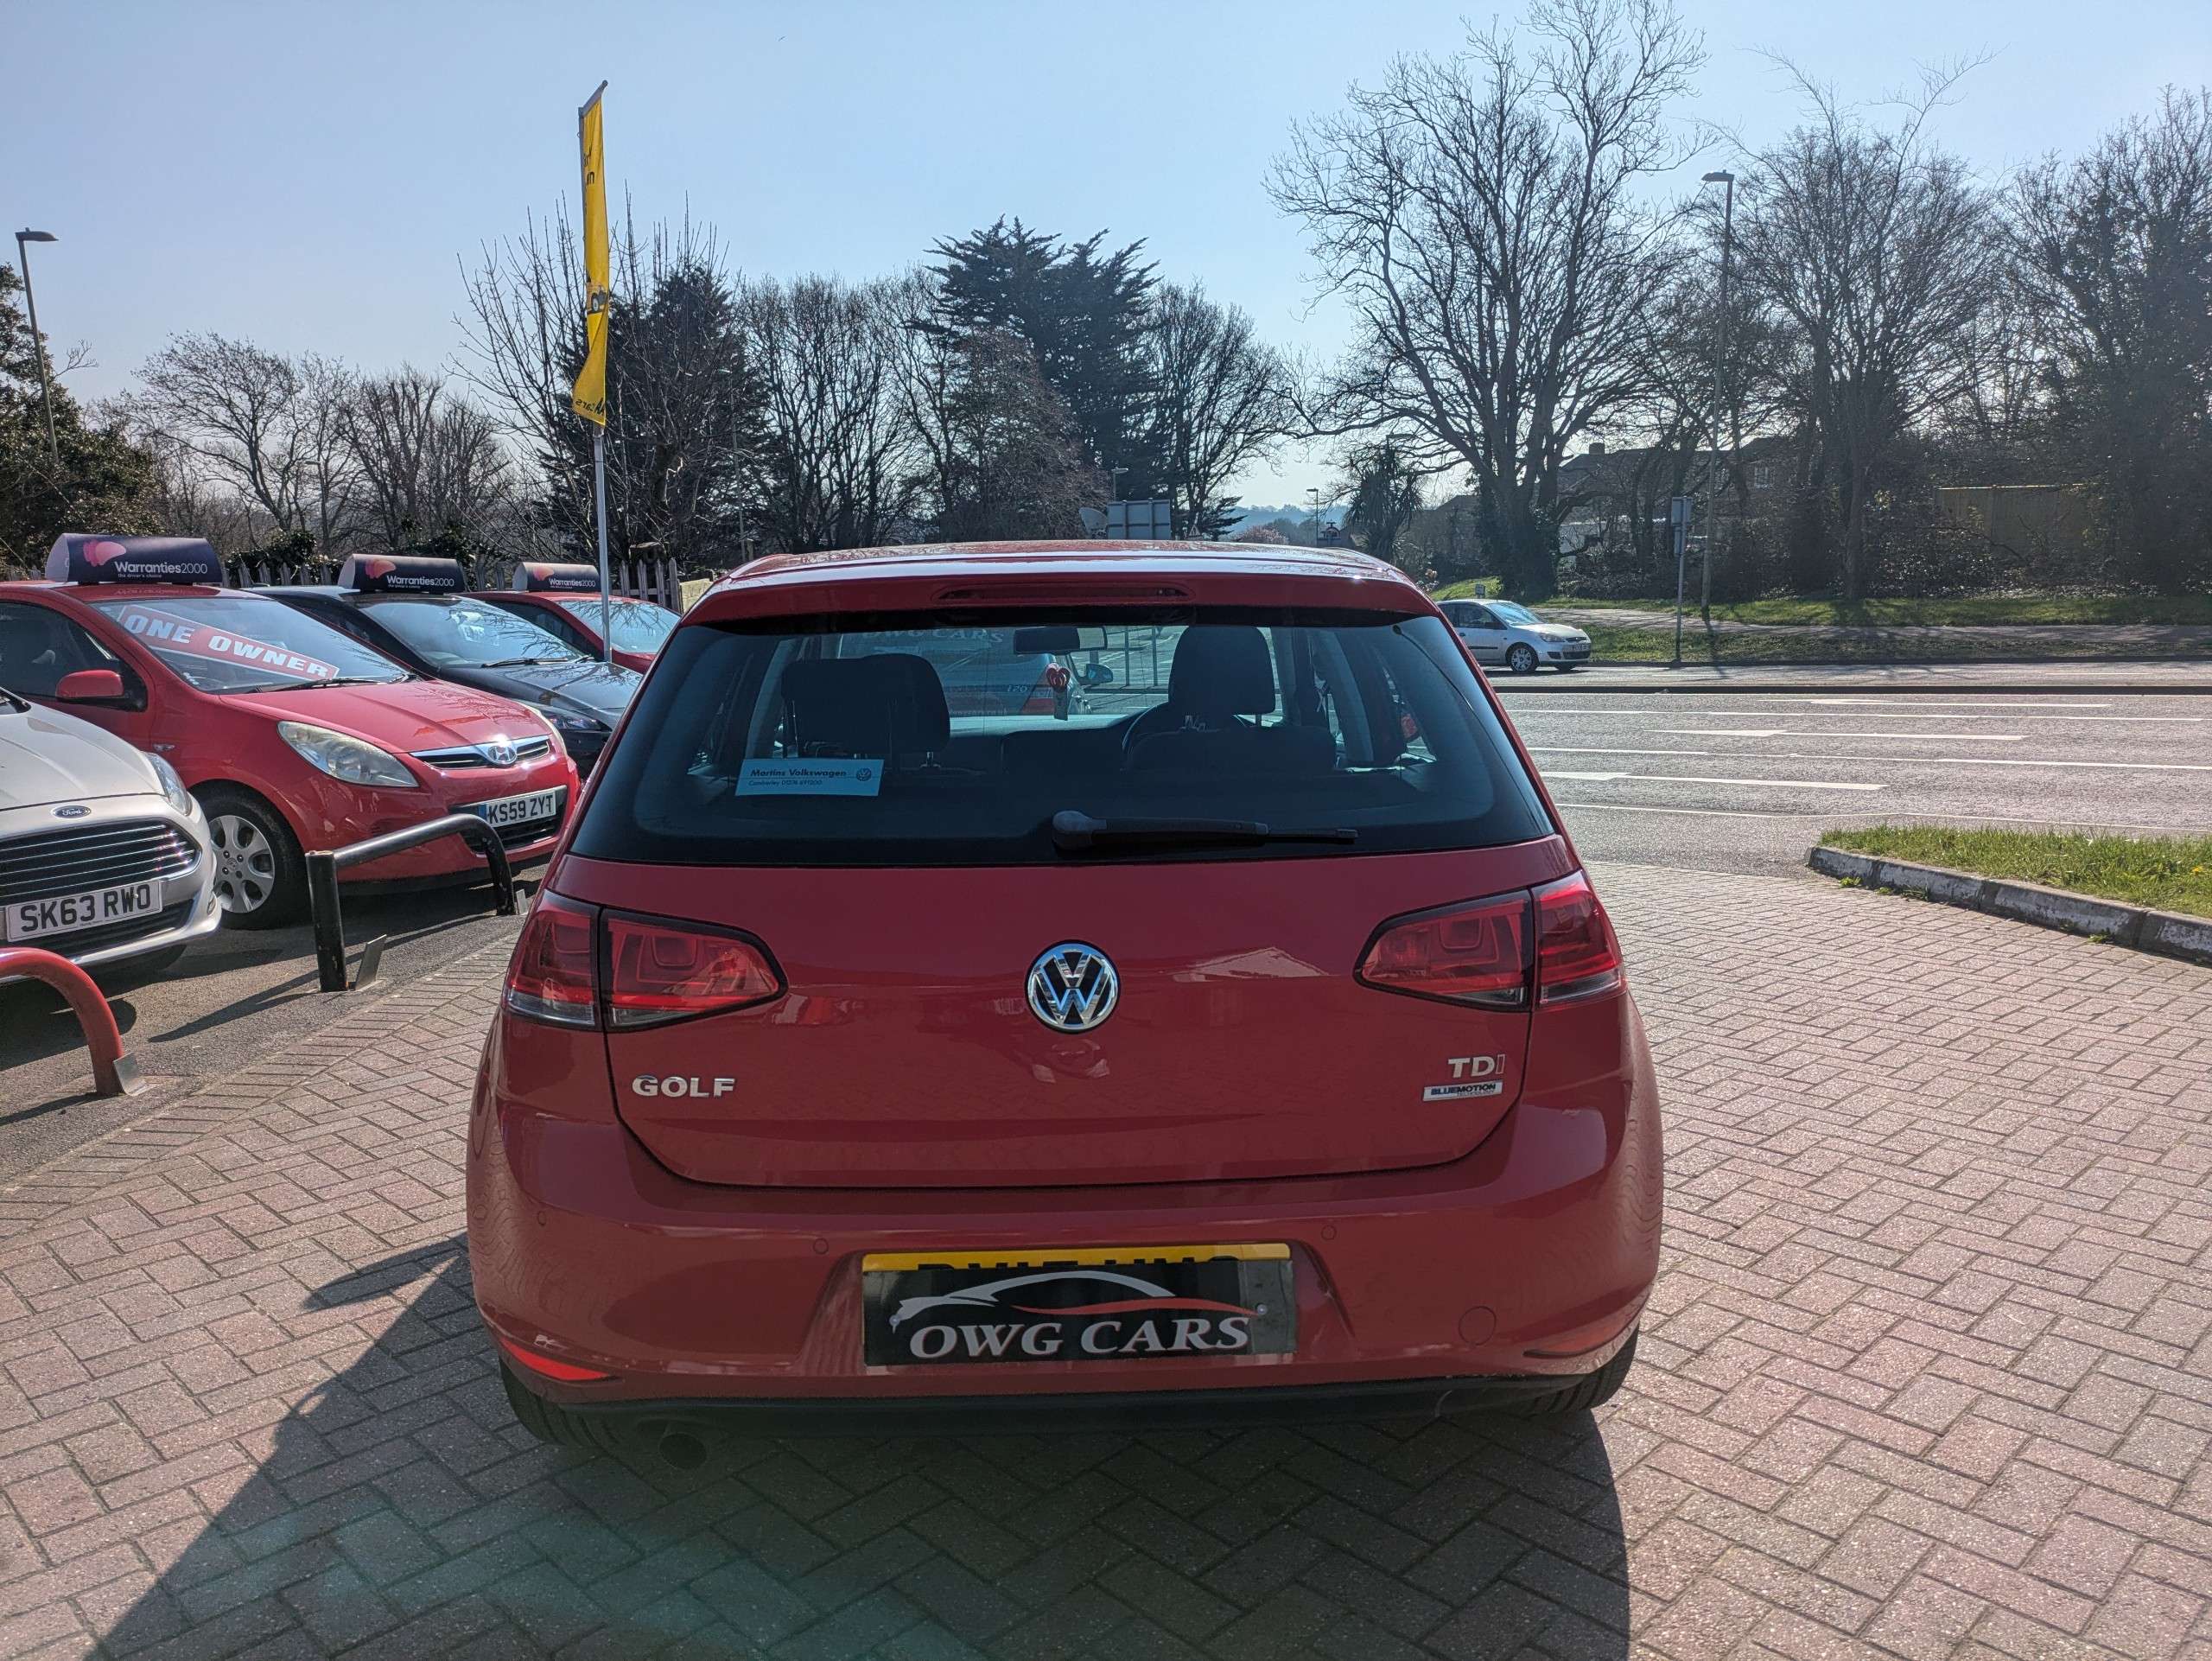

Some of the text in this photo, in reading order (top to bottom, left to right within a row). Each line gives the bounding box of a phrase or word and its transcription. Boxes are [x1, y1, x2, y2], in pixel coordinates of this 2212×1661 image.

[115, 562, 208, 574] Warranties2000
[386, 575, 454, 587] Warranties2000
[549, 577, 596, 588] Warranties2000
[124, 614, 329, 678] ONE OWNER
[750, 767, 847, 778] Martins Volkswagen
[488, 795, 553, 824] KS59 ZYT
[21, 884, 150, 932] SK63 RWO
[632, 1075, 735, 1098] GOLF
[1431, 1084, 1496, 1096] BLUEMOTION
[910, 1317, 1249, 1359] OWG CARS
